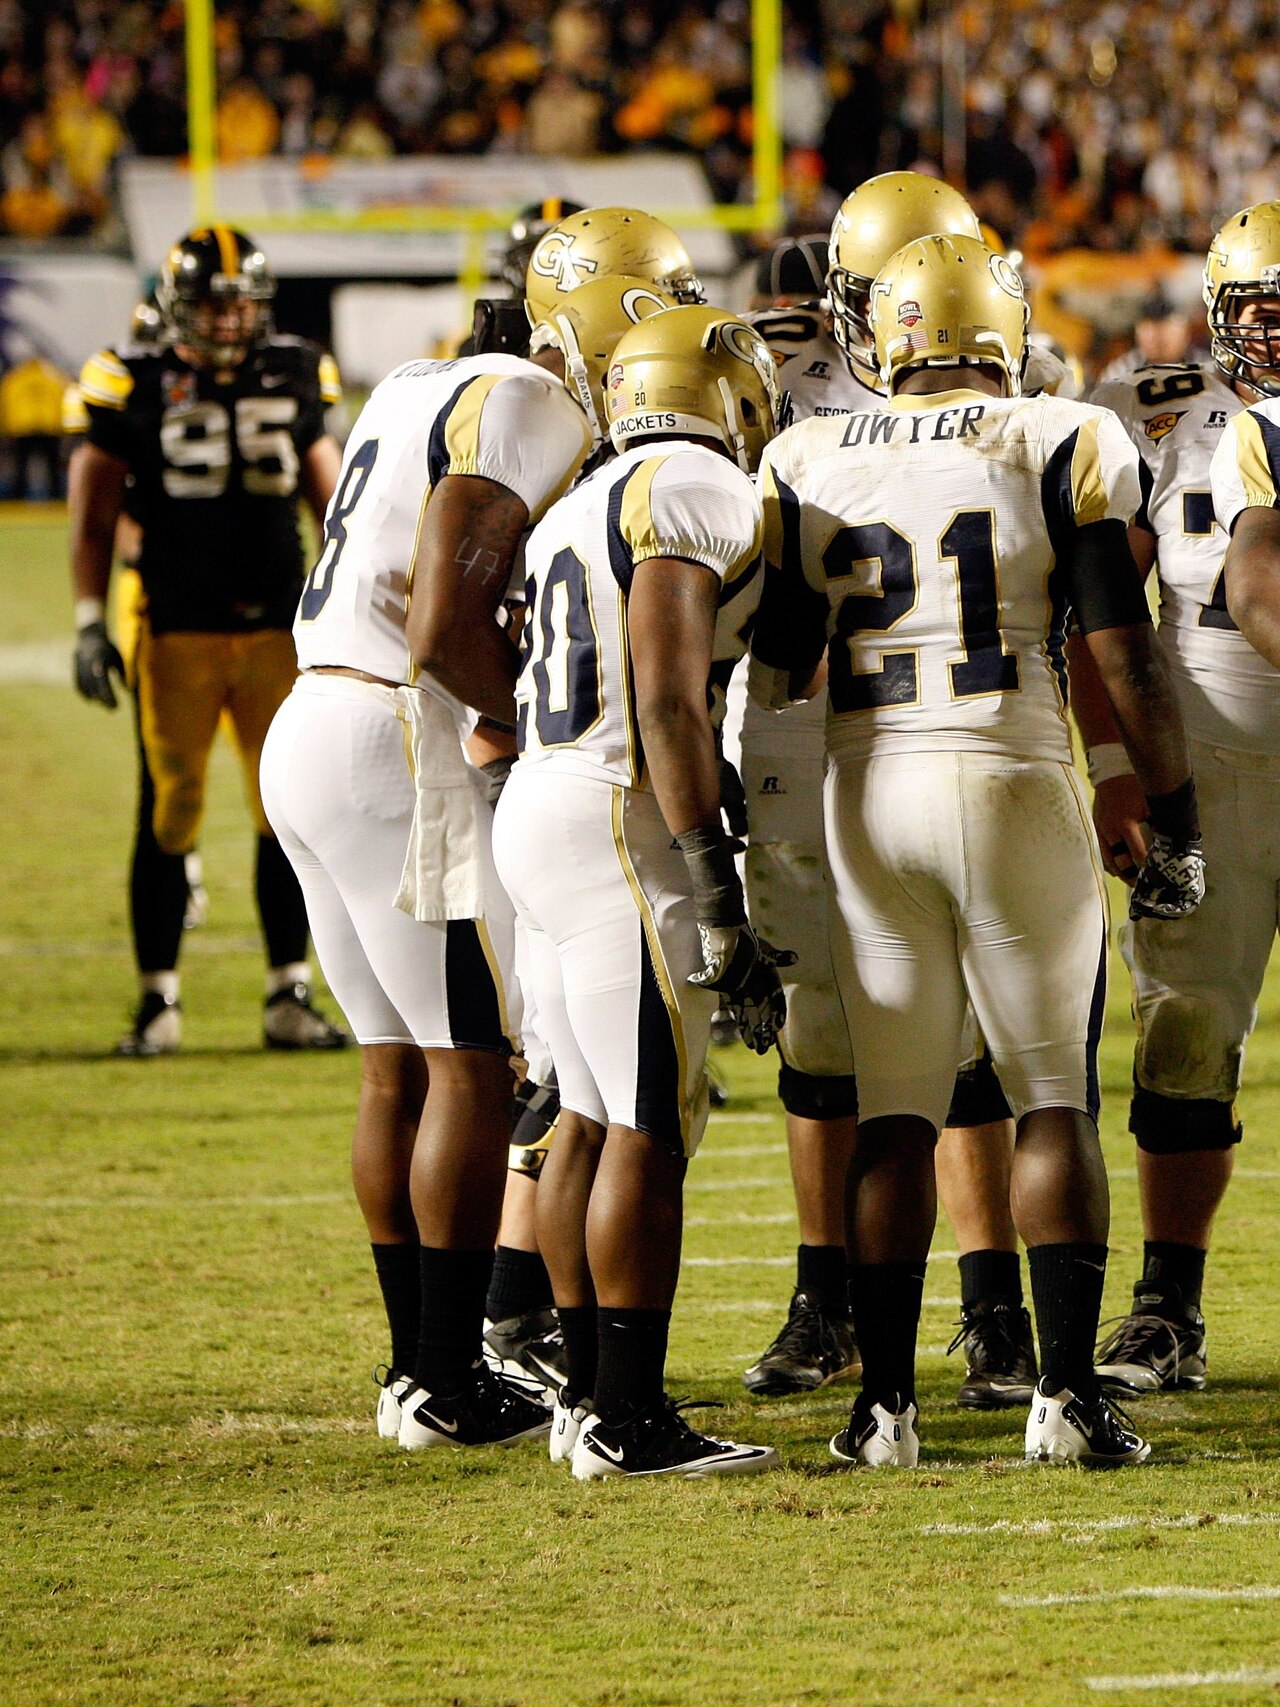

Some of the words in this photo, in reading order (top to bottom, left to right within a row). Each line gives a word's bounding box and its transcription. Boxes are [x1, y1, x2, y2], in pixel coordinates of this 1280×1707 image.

[937, 329, 949, 343] 21
[634, 392, 646, 406] 20
[616, 413, 677, 435] JACKETS
[839, 405, 986, 448] DWYER
[1148, 417, 1173, 435] ACC
[160, 398, 300, 499] 95
[300, 438, 380, 624] 8
[820, 507, 1022, 715] 21
